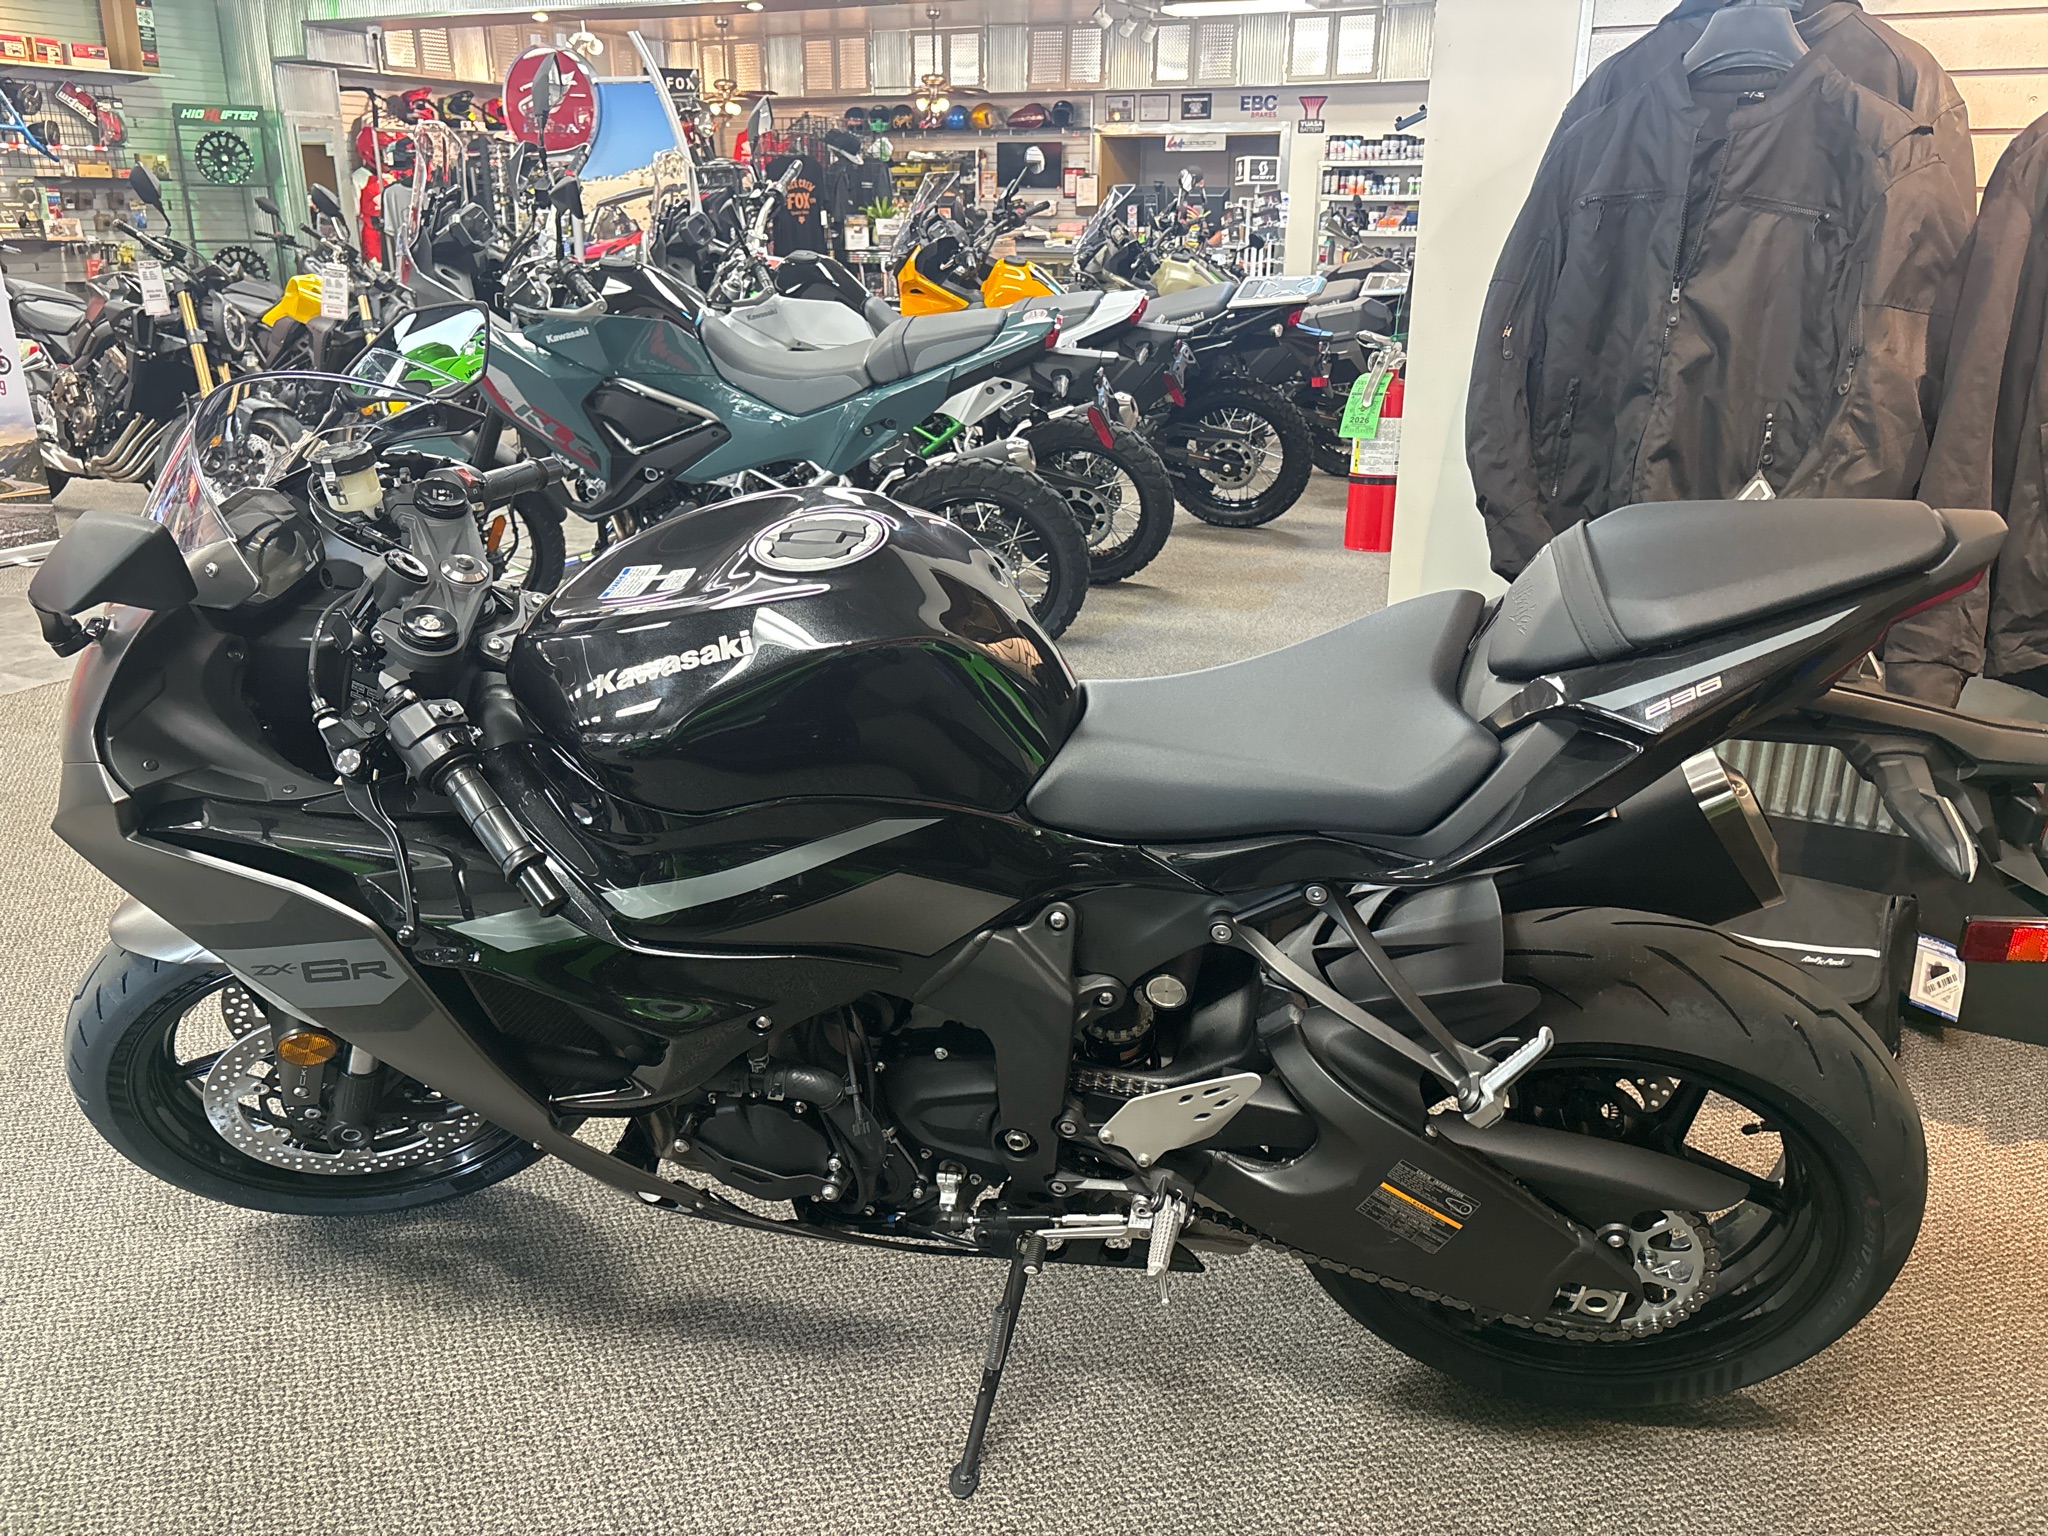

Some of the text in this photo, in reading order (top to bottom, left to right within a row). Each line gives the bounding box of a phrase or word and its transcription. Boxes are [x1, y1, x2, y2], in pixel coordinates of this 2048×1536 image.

[665, 77, 695, 90] FOX
[1240, 94, 1278, 111] EBC
[787, 192, 811, 210] FOX
[746, 308, 778, 321] Kawasaki
[545, 326, 590, 344] Kawasaki
[1349, 416, 1370, 425] 2026
[595, 629, 755, 700] Kawasaki
[250, 958, 395, 984] ZX-6R
